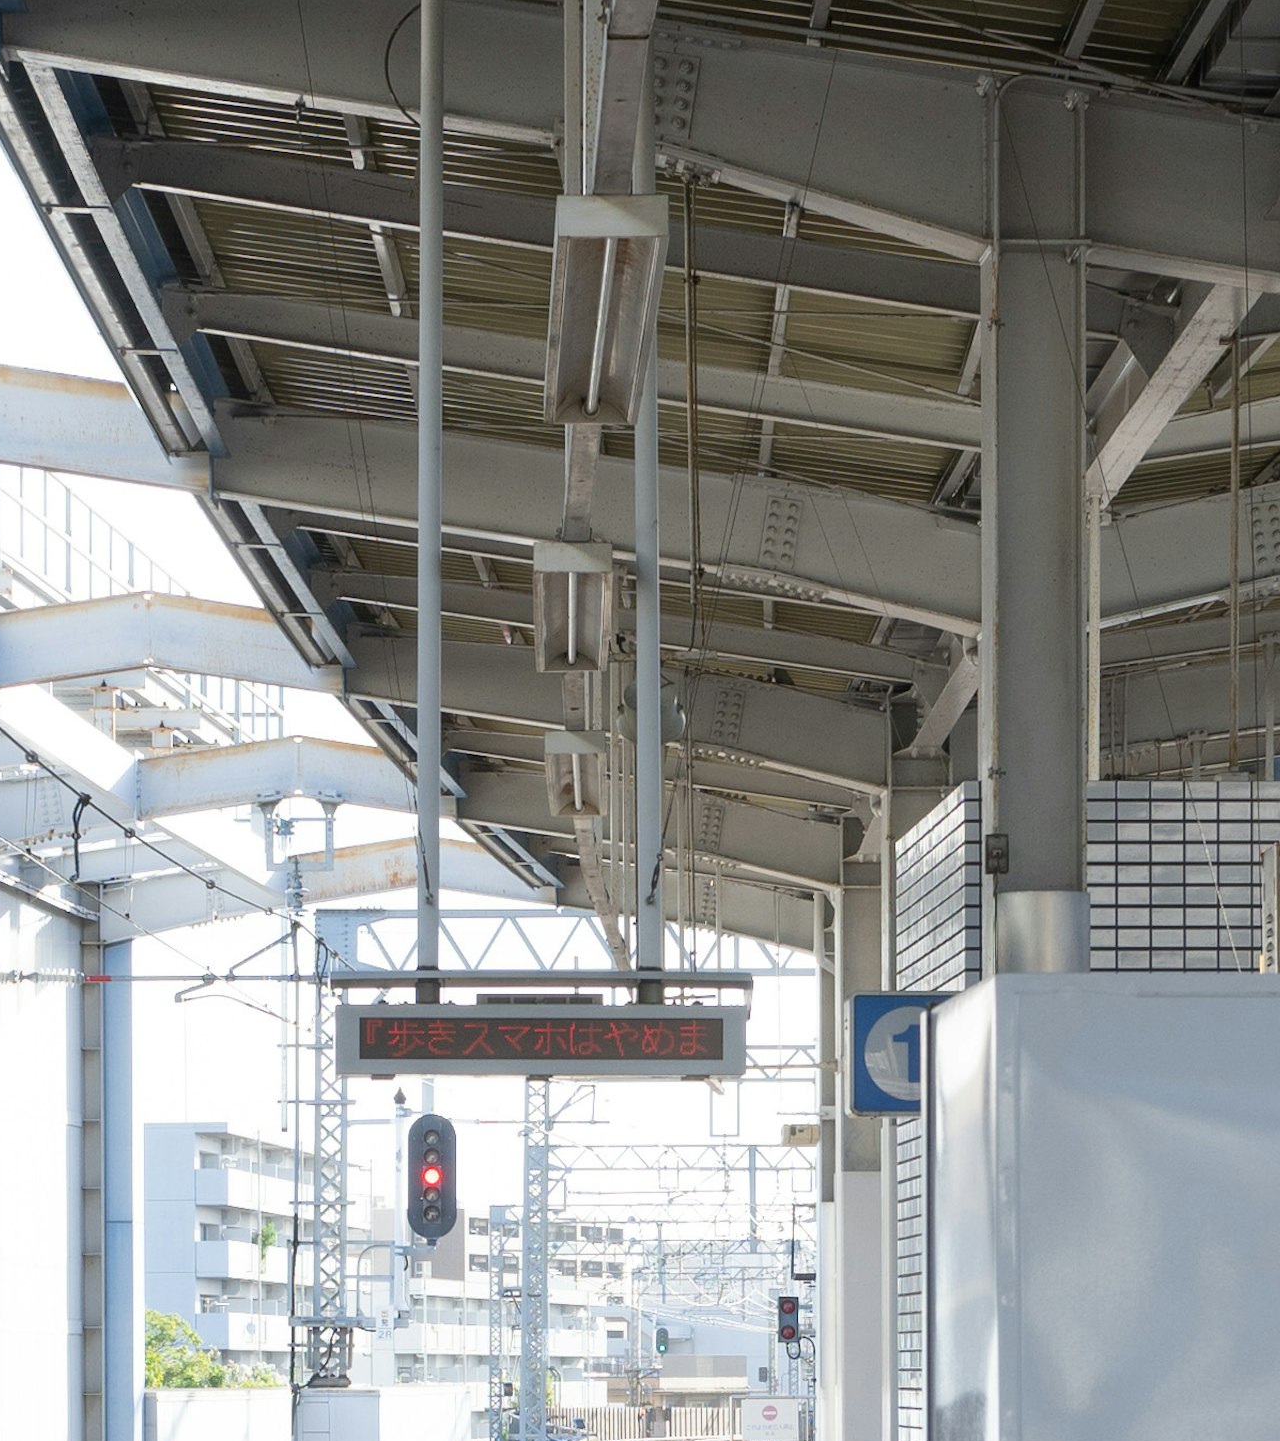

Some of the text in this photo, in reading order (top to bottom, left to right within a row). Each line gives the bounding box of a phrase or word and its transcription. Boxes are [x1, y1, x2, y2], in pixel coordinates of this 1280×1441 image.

[365, 1019, 709, 1057] 『歩きスマホはやめま
[892, 1024, 921, 1083] 1
